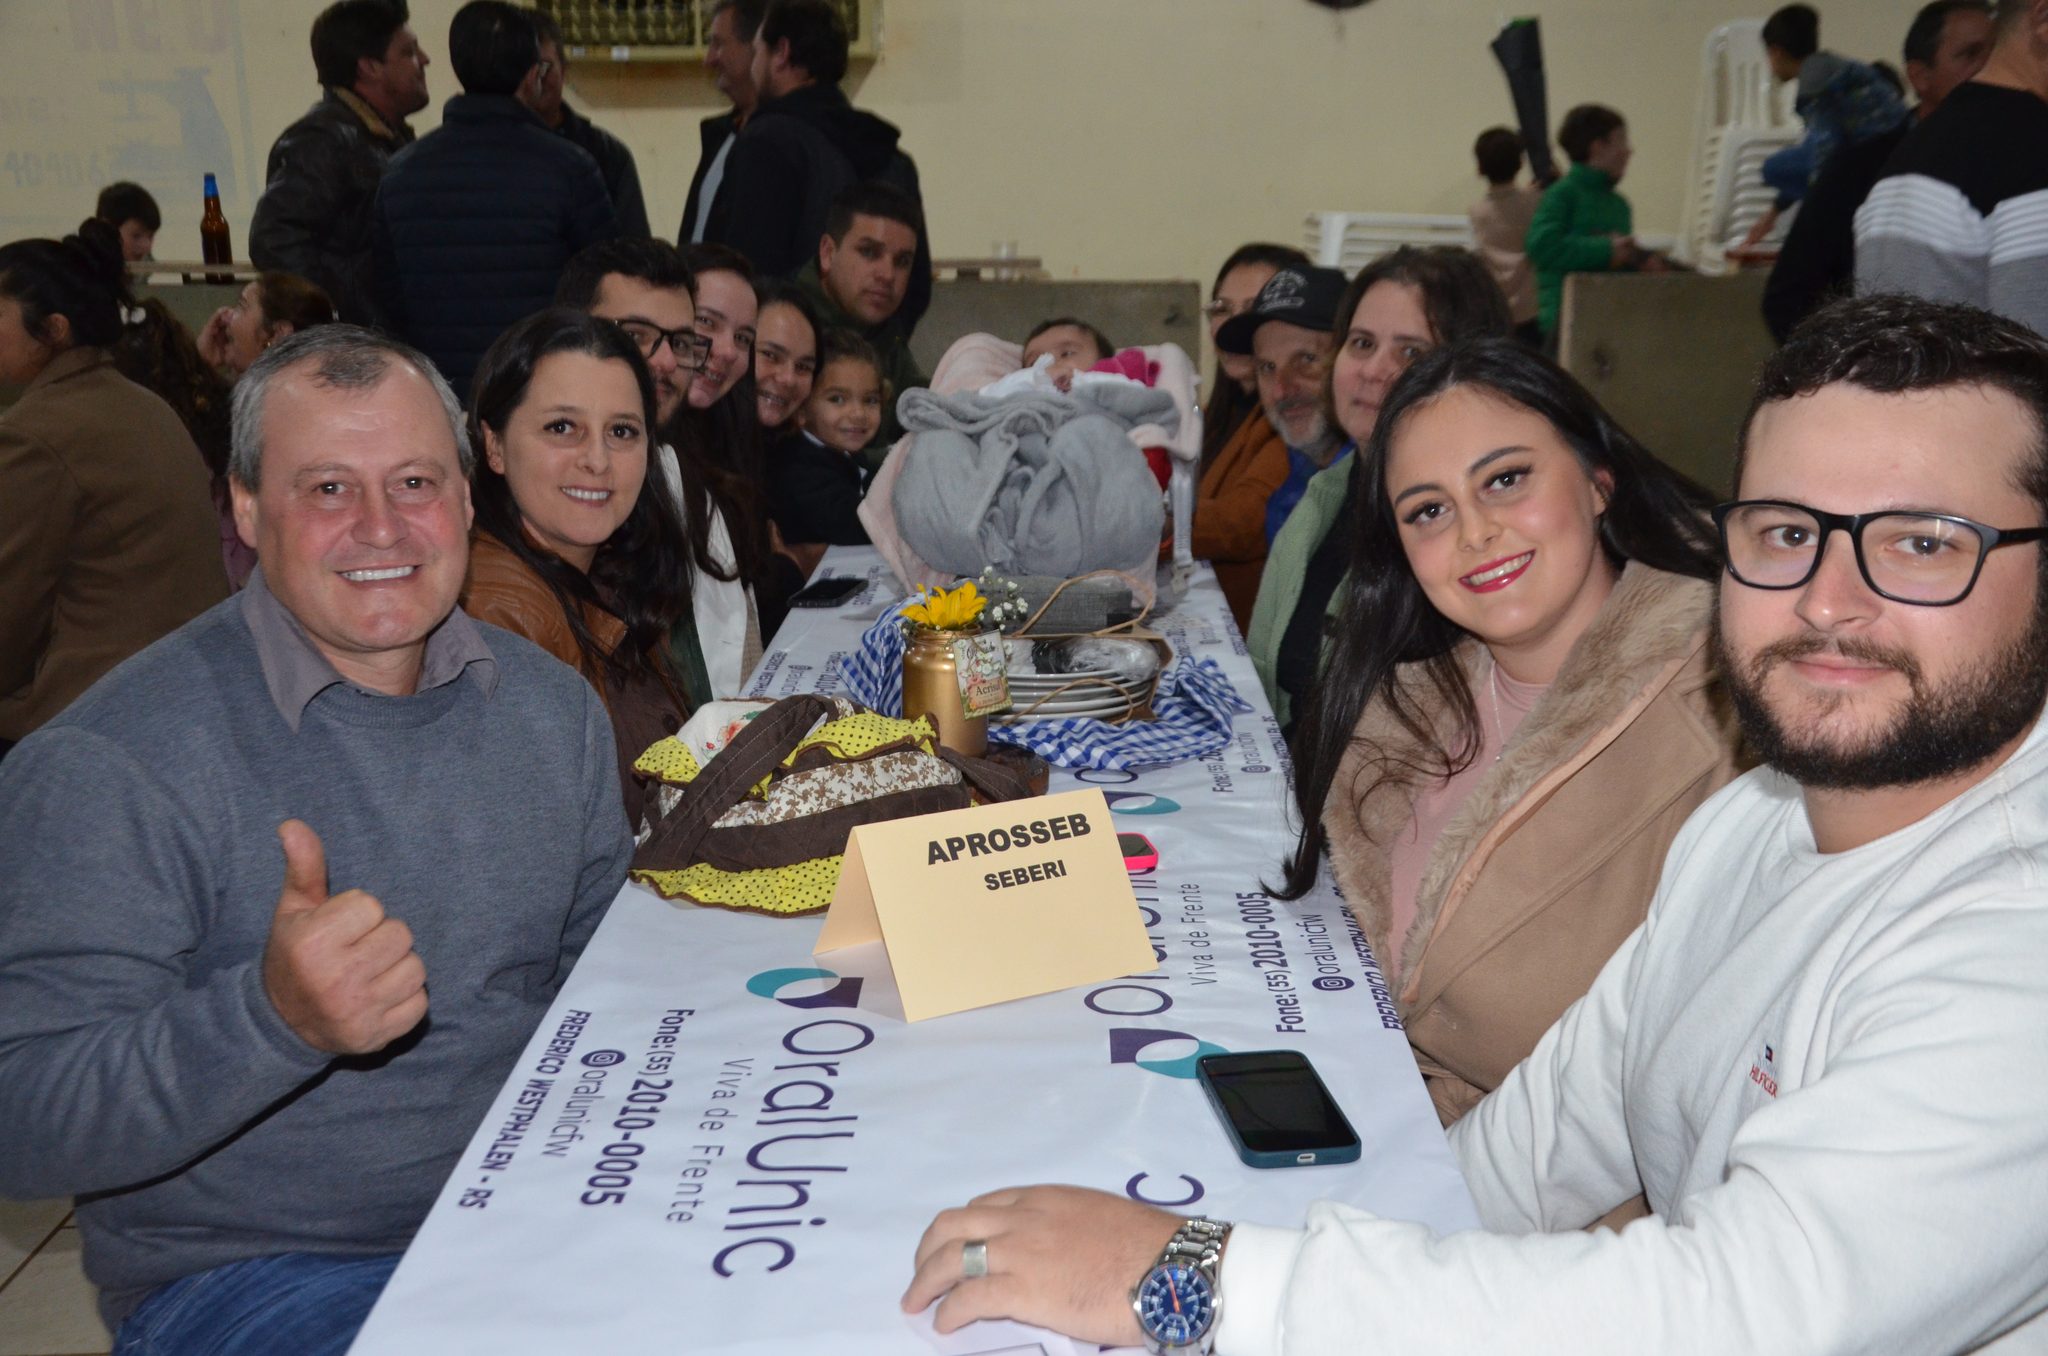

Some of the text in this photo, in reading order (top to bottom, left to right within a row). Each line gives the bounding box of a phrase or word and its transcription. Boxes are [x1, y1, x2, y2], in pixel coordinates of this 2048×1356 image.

[928, 813, 1091, 865] APROSSEB
[984, 859, 1067, 891] SEBERI
[1178, 883, 1218, 986] Viva de Frente
[536, 1008, 592, 1075] FREDERICO
[478, 1078, 556, 1171] WESTPHALEN
[665, 1058, 755, 1223] Viva de Frente
[712, 1019, 875, 1278] OralUnic
[458, 1187, 495, 1209] RS
